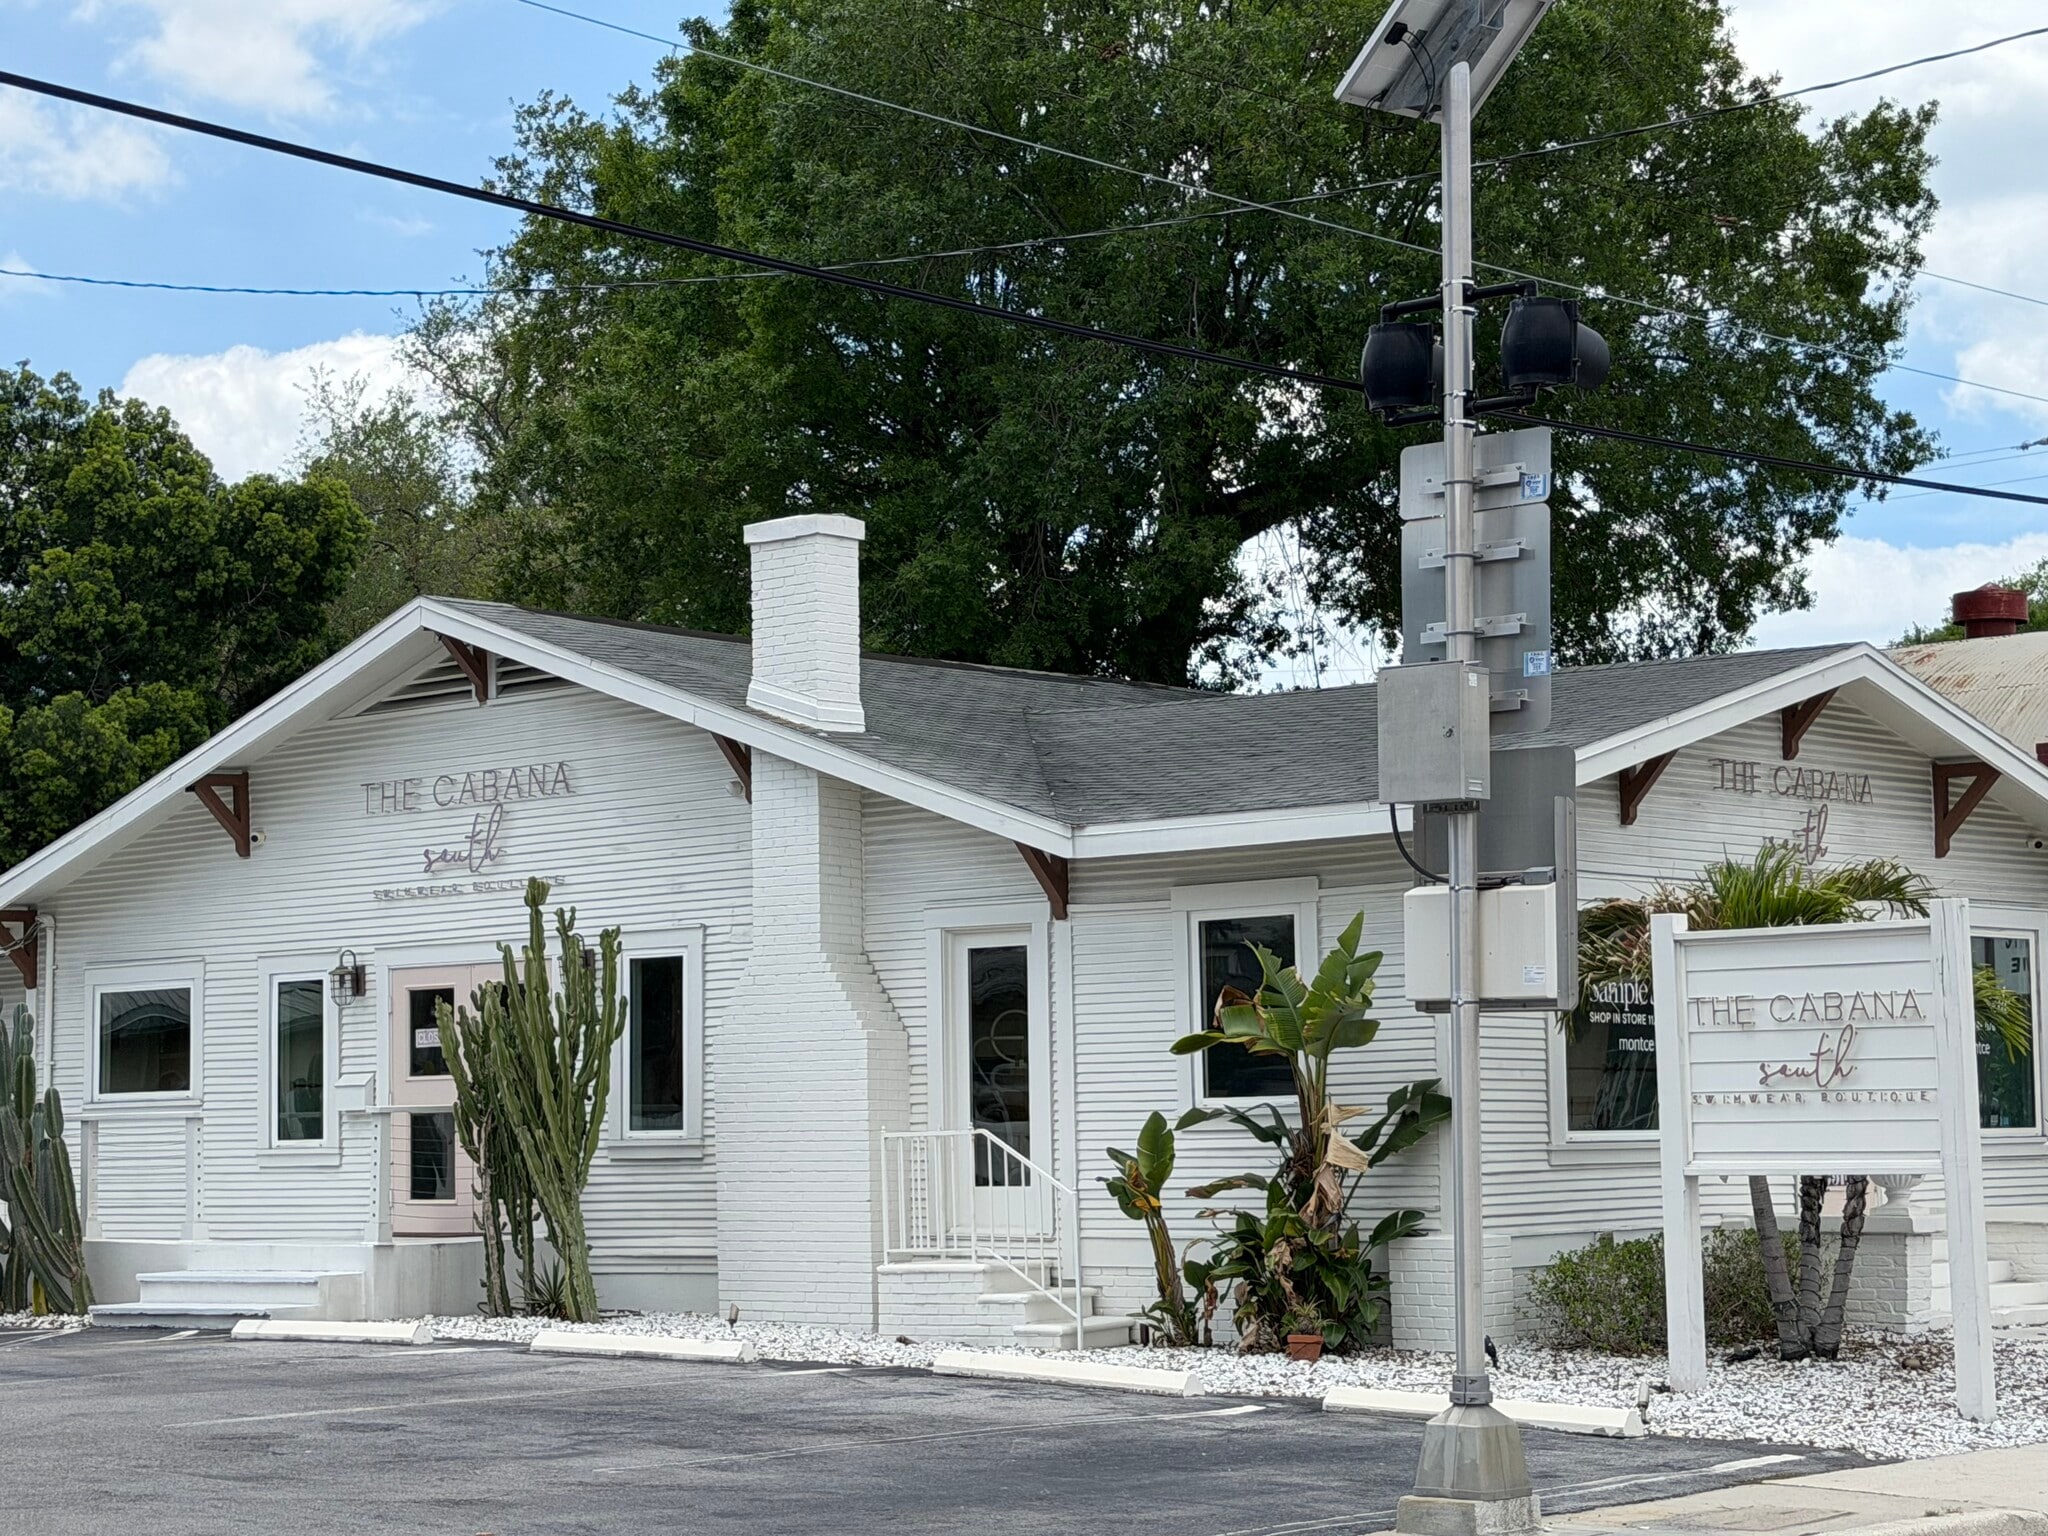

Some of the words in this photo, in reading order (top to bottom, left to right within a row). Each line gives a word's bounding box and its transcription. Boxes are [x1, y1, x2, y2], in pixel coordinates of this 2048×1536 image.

[360, 778, 422, 814] THE
[432, 760, 575, 807] CABANA
[1709, 758, 1761, 793] THE
[1772, 765, 1874, 804] CABANA
[423, 802, 506, 873] south
[1588, 1011, 1612, 1023] SHOP
[1612, 1012, 1621, 1024] IN
[1621, 1012, 1647, 1025] STORE
[1688, 995, 1755, 1026] THE
[1769, 988, 1926, 1023] CABANA
[418, 1031, 440, 1044] CLOS
[1618, 1036, 1655, 1051] montce
[1759, 1023, 1857, 1088] south
[1691, 1093, 1806, 1106] SWIMWEAR
[1820, 1091, 1930, 1105] BOUTIQUE
